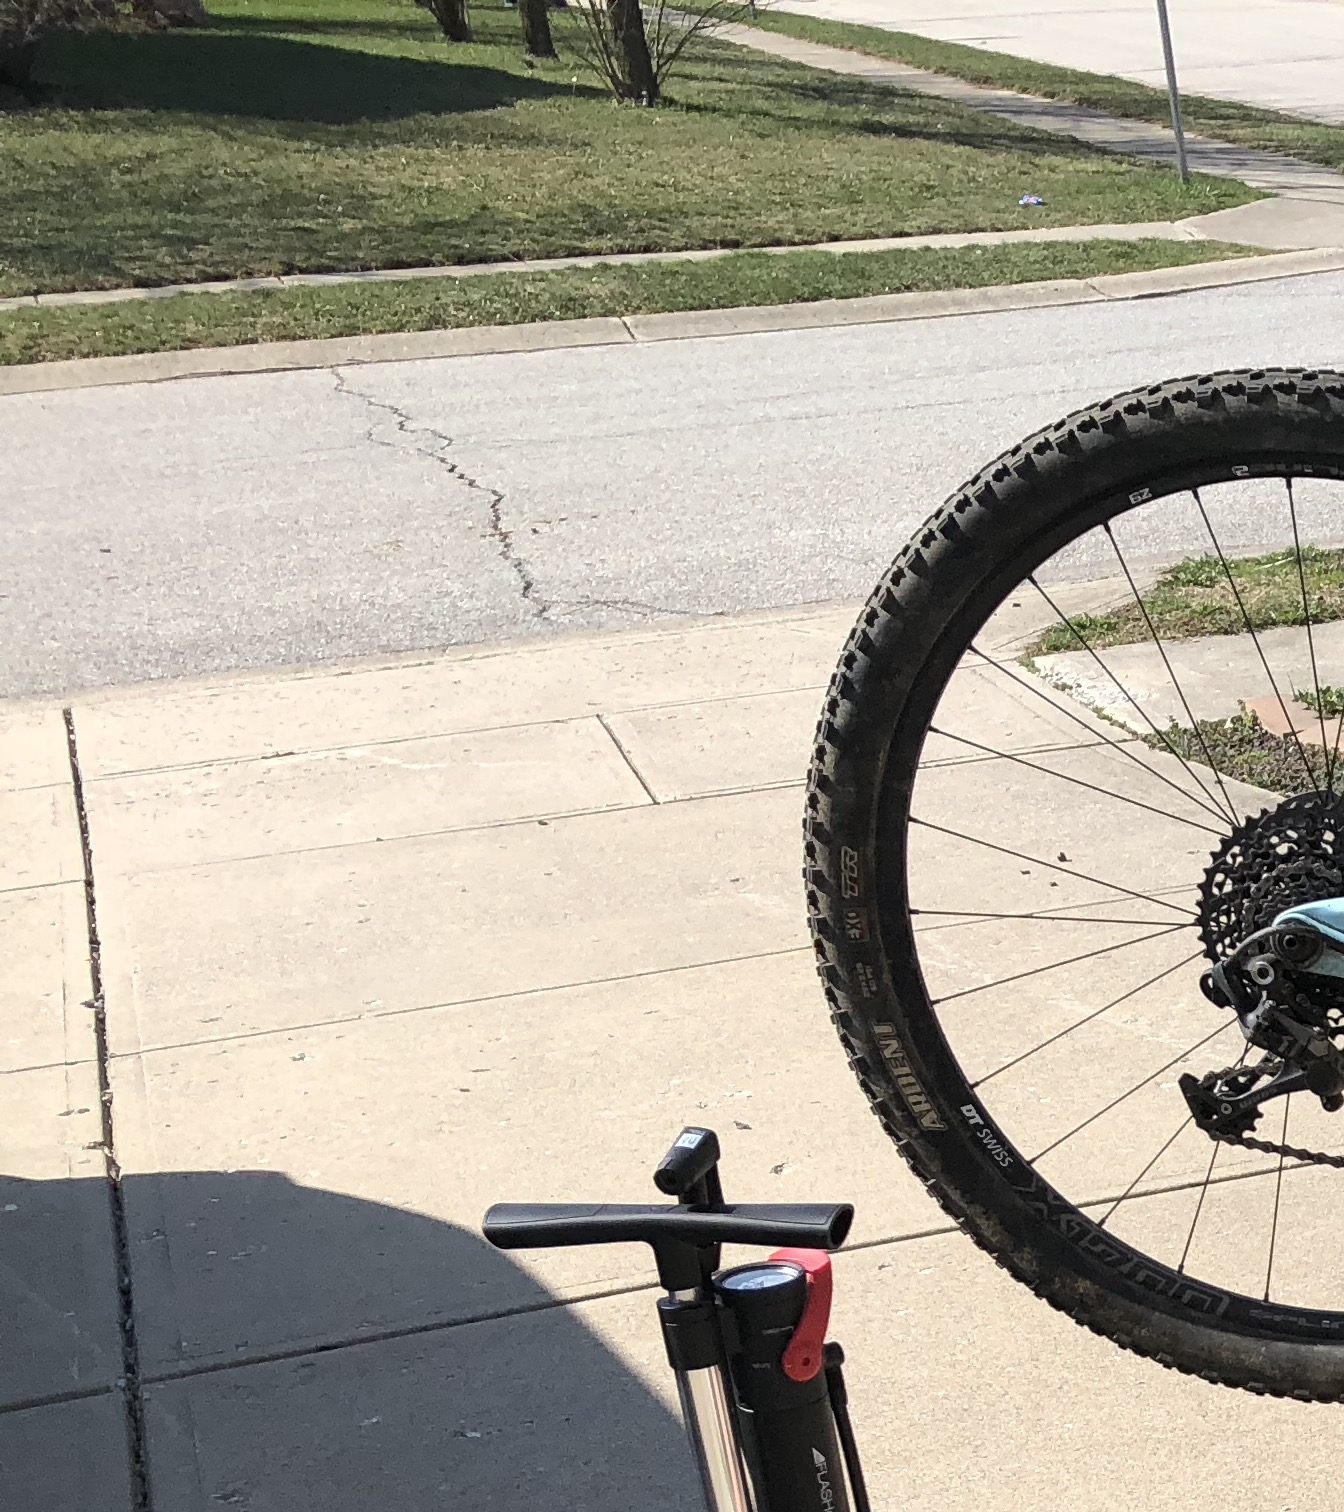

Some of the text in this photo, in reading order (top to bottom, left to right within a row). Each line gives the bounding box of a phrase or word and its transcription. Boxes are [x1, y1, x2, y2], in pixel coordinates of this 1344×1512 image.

[869, 1019, 949, 1132] ARDENT
[959, 1103, 1014, 1169] DT SWISS
